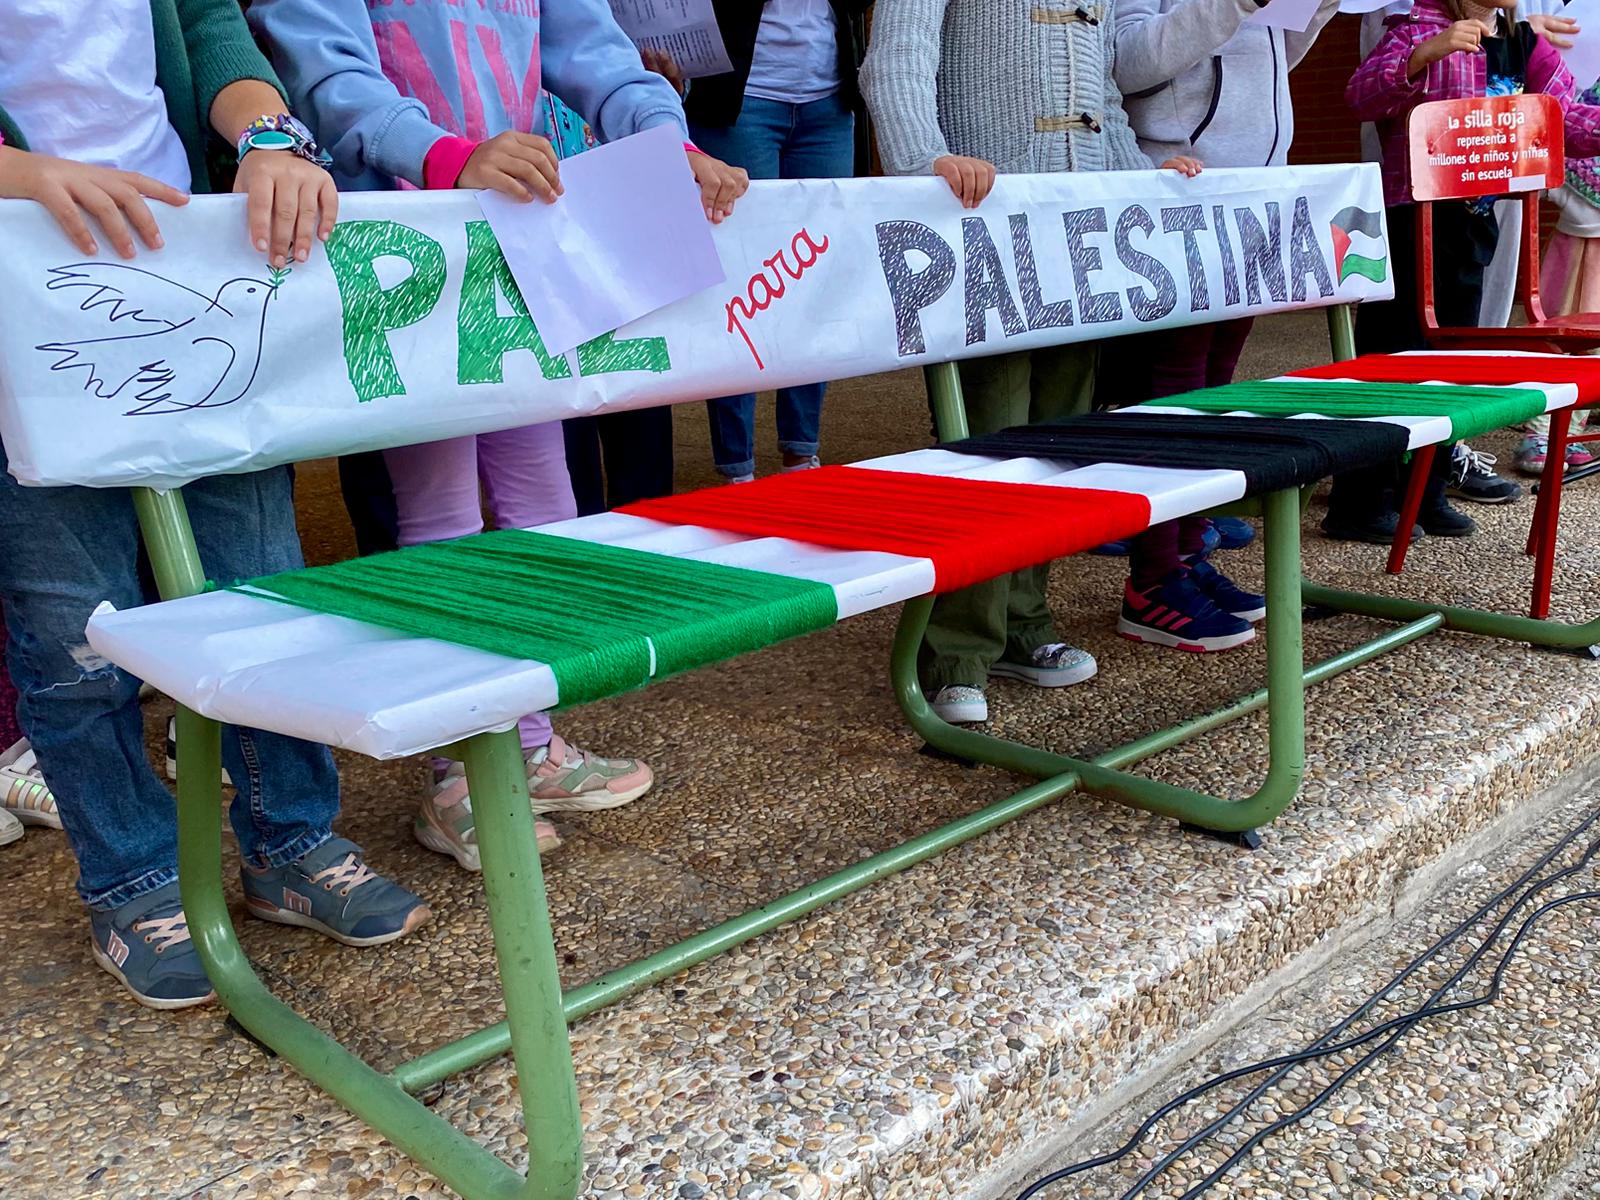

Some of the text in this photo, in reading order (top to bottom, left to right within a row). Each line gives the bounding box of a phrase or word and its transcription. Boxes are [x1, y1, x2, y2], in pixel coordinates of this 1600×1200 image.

[1464, 109, 1493, 128] silla
[1497, 107, 1525, 129] roja
[1457, 133, 1516, 149] representa a
[1429, 147, 1549, 166] millones de niños y niñas
[1461, 166, 1513, 182] sin escuela
[724, 227, 829, 371] para
[874, 195, 1335, 357] PALESTINA
